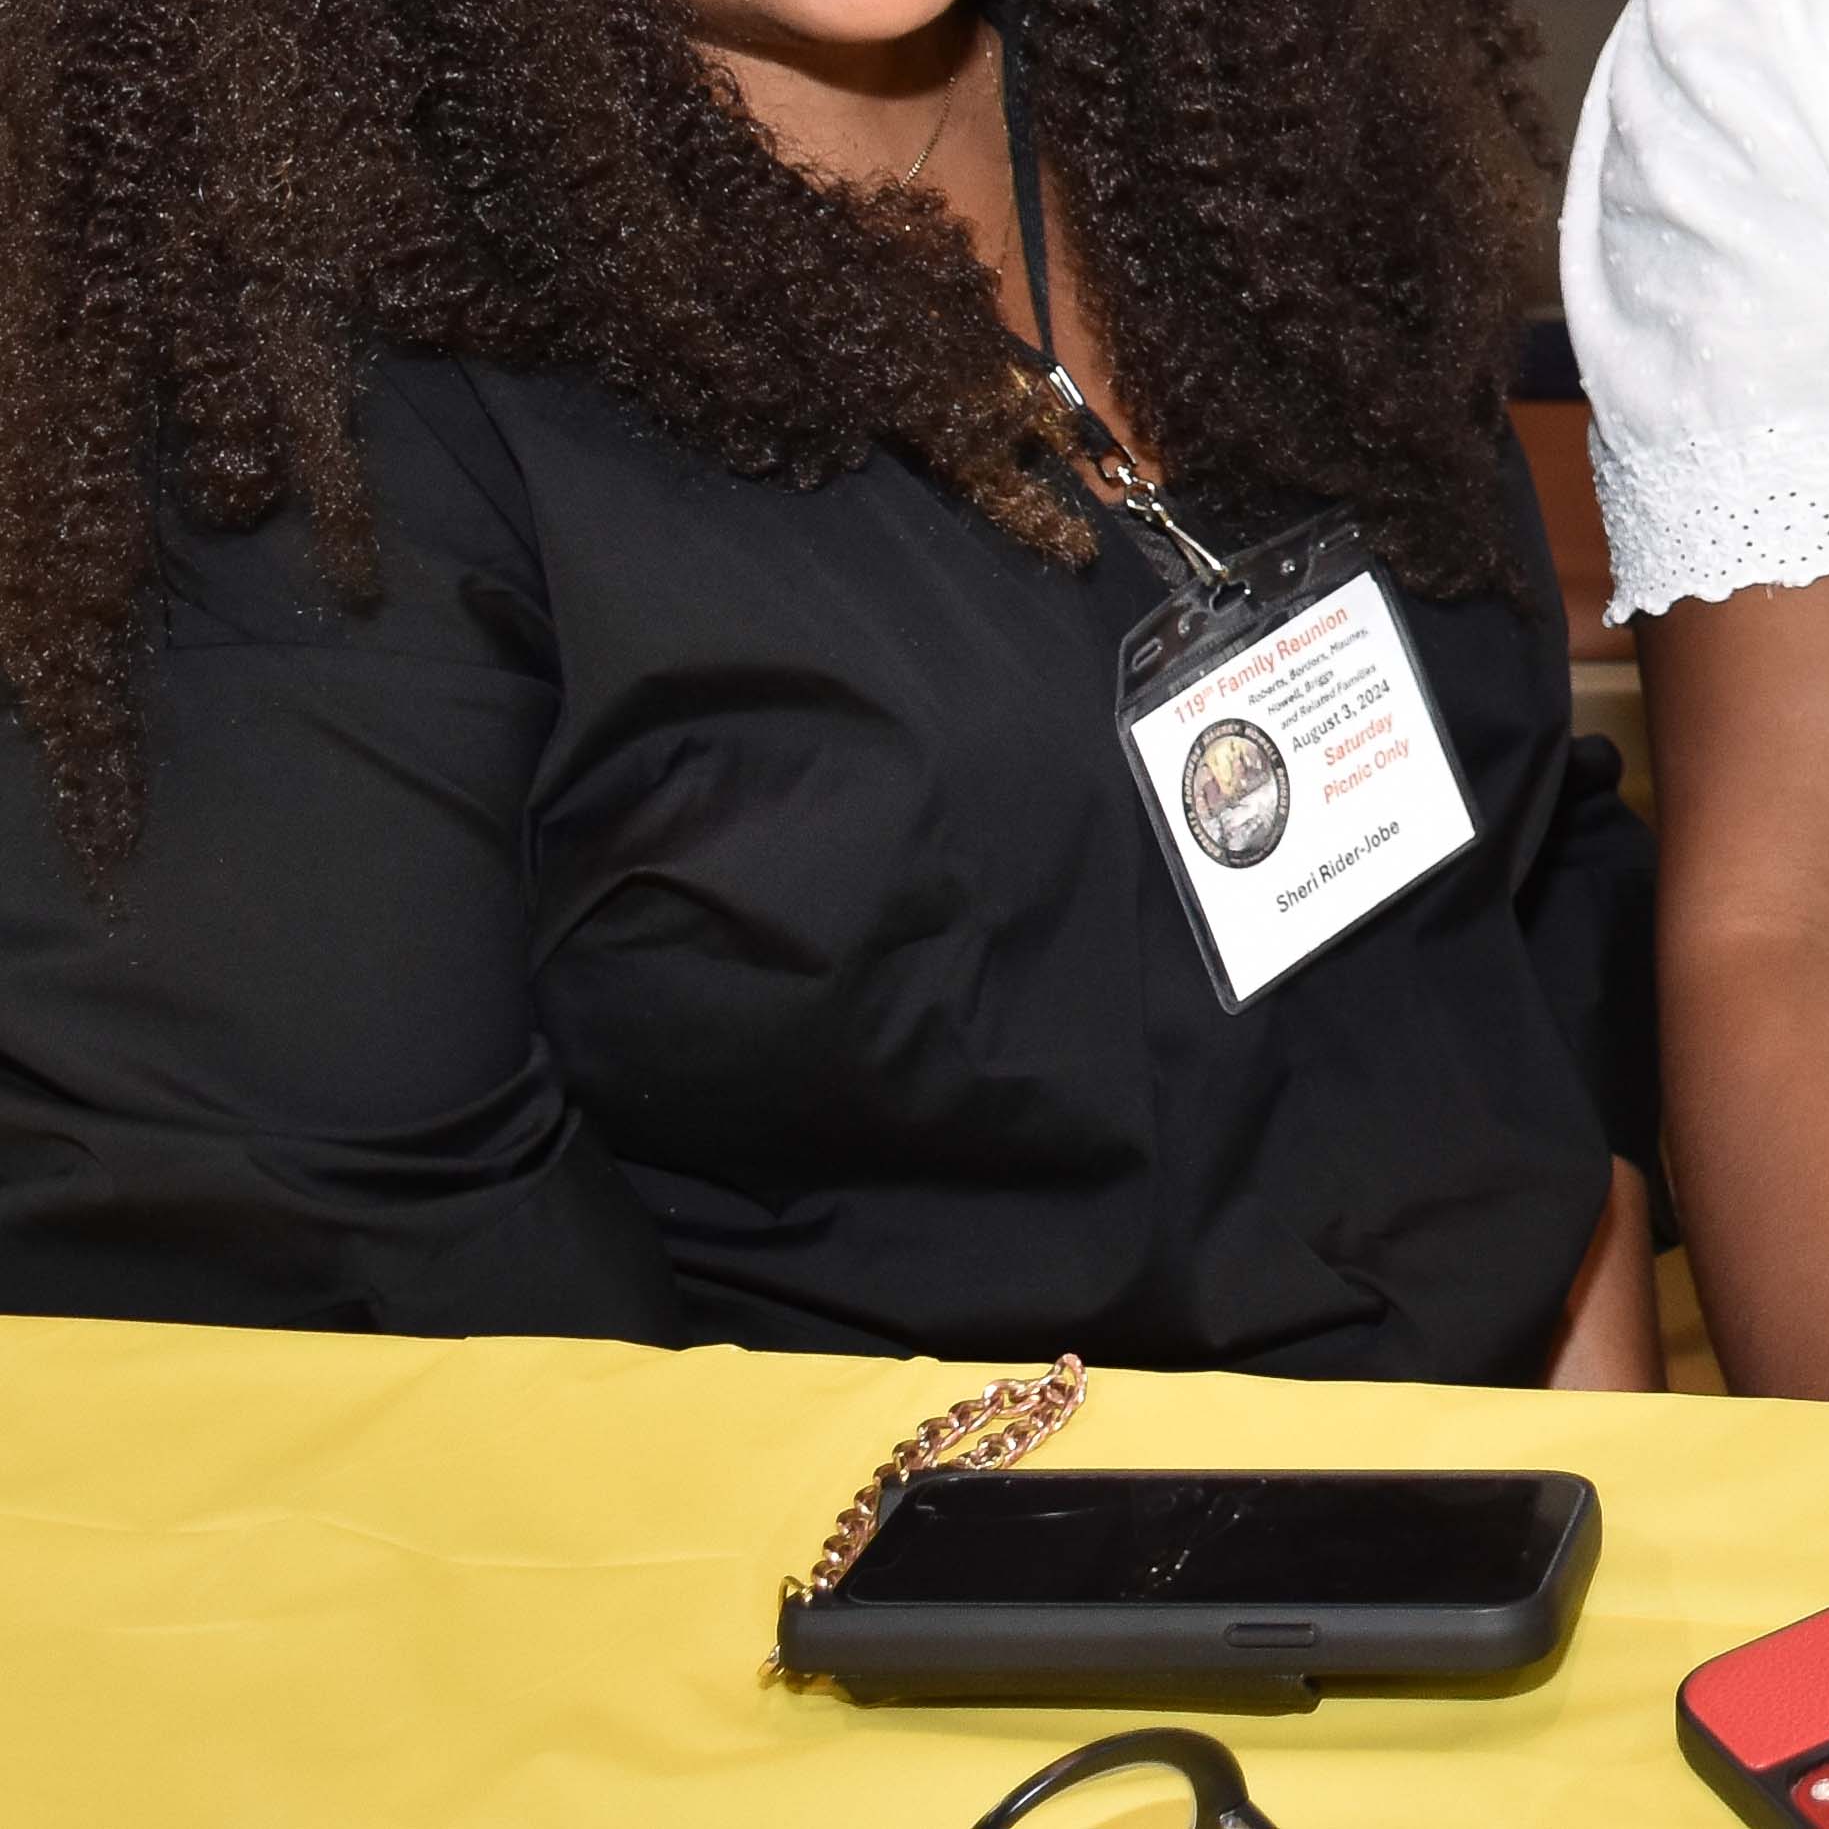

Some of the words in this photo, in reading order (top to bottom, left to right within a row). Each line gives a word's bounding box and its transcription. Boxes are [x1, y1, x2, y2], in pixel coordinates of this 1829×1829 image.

[1217, 651, 1276, 700] Family
[1277, 607, 1349, 666] Reunion
[1280, 712, 1299, 730] and
[1300, 688, 1337, 718] Related
[1337, 664, 1377, 695] Families
[1292, 712, 1341, 753] August
[1341, 703, 1357, 719] 3,
[1357, 679, 1390, 710] 2024
[1323, 763, 1373, 804] Picnic
[1374, 738, 1409, 769] Only
[1324, 713, 1393, 766] Saturday
[1276, 872, 1319, 913] Sheri
[1318, 821, 1400, 884] Rider-Jobe
